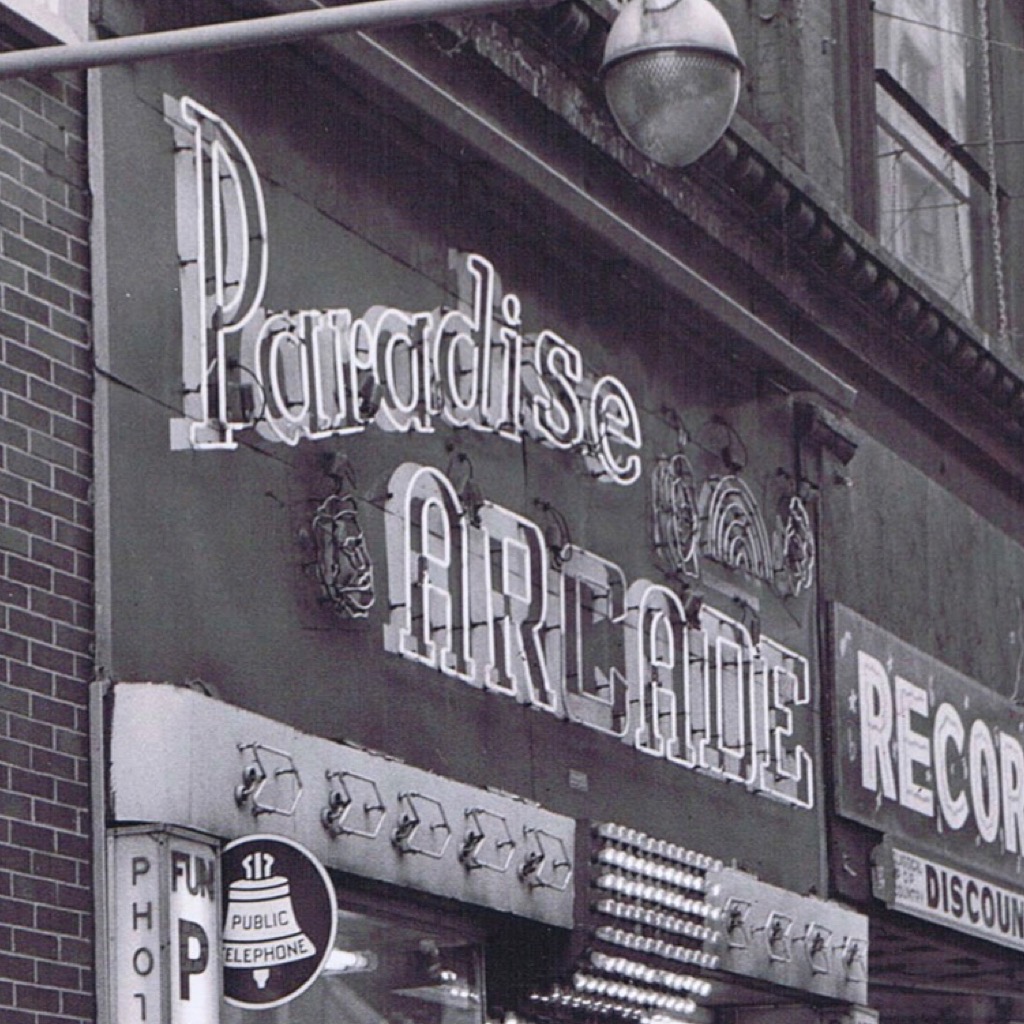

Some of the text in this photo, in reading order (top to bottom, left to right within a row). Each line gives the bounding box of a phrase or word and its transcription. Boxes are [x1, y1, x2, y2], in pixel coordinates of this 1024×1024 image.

[163, 94, 645, 486] Paradise
[384, 463, 814, 809] ARCADE
[171, 850, 217, 902] FUN
[231, 910, 288, 930] PUBLIC
